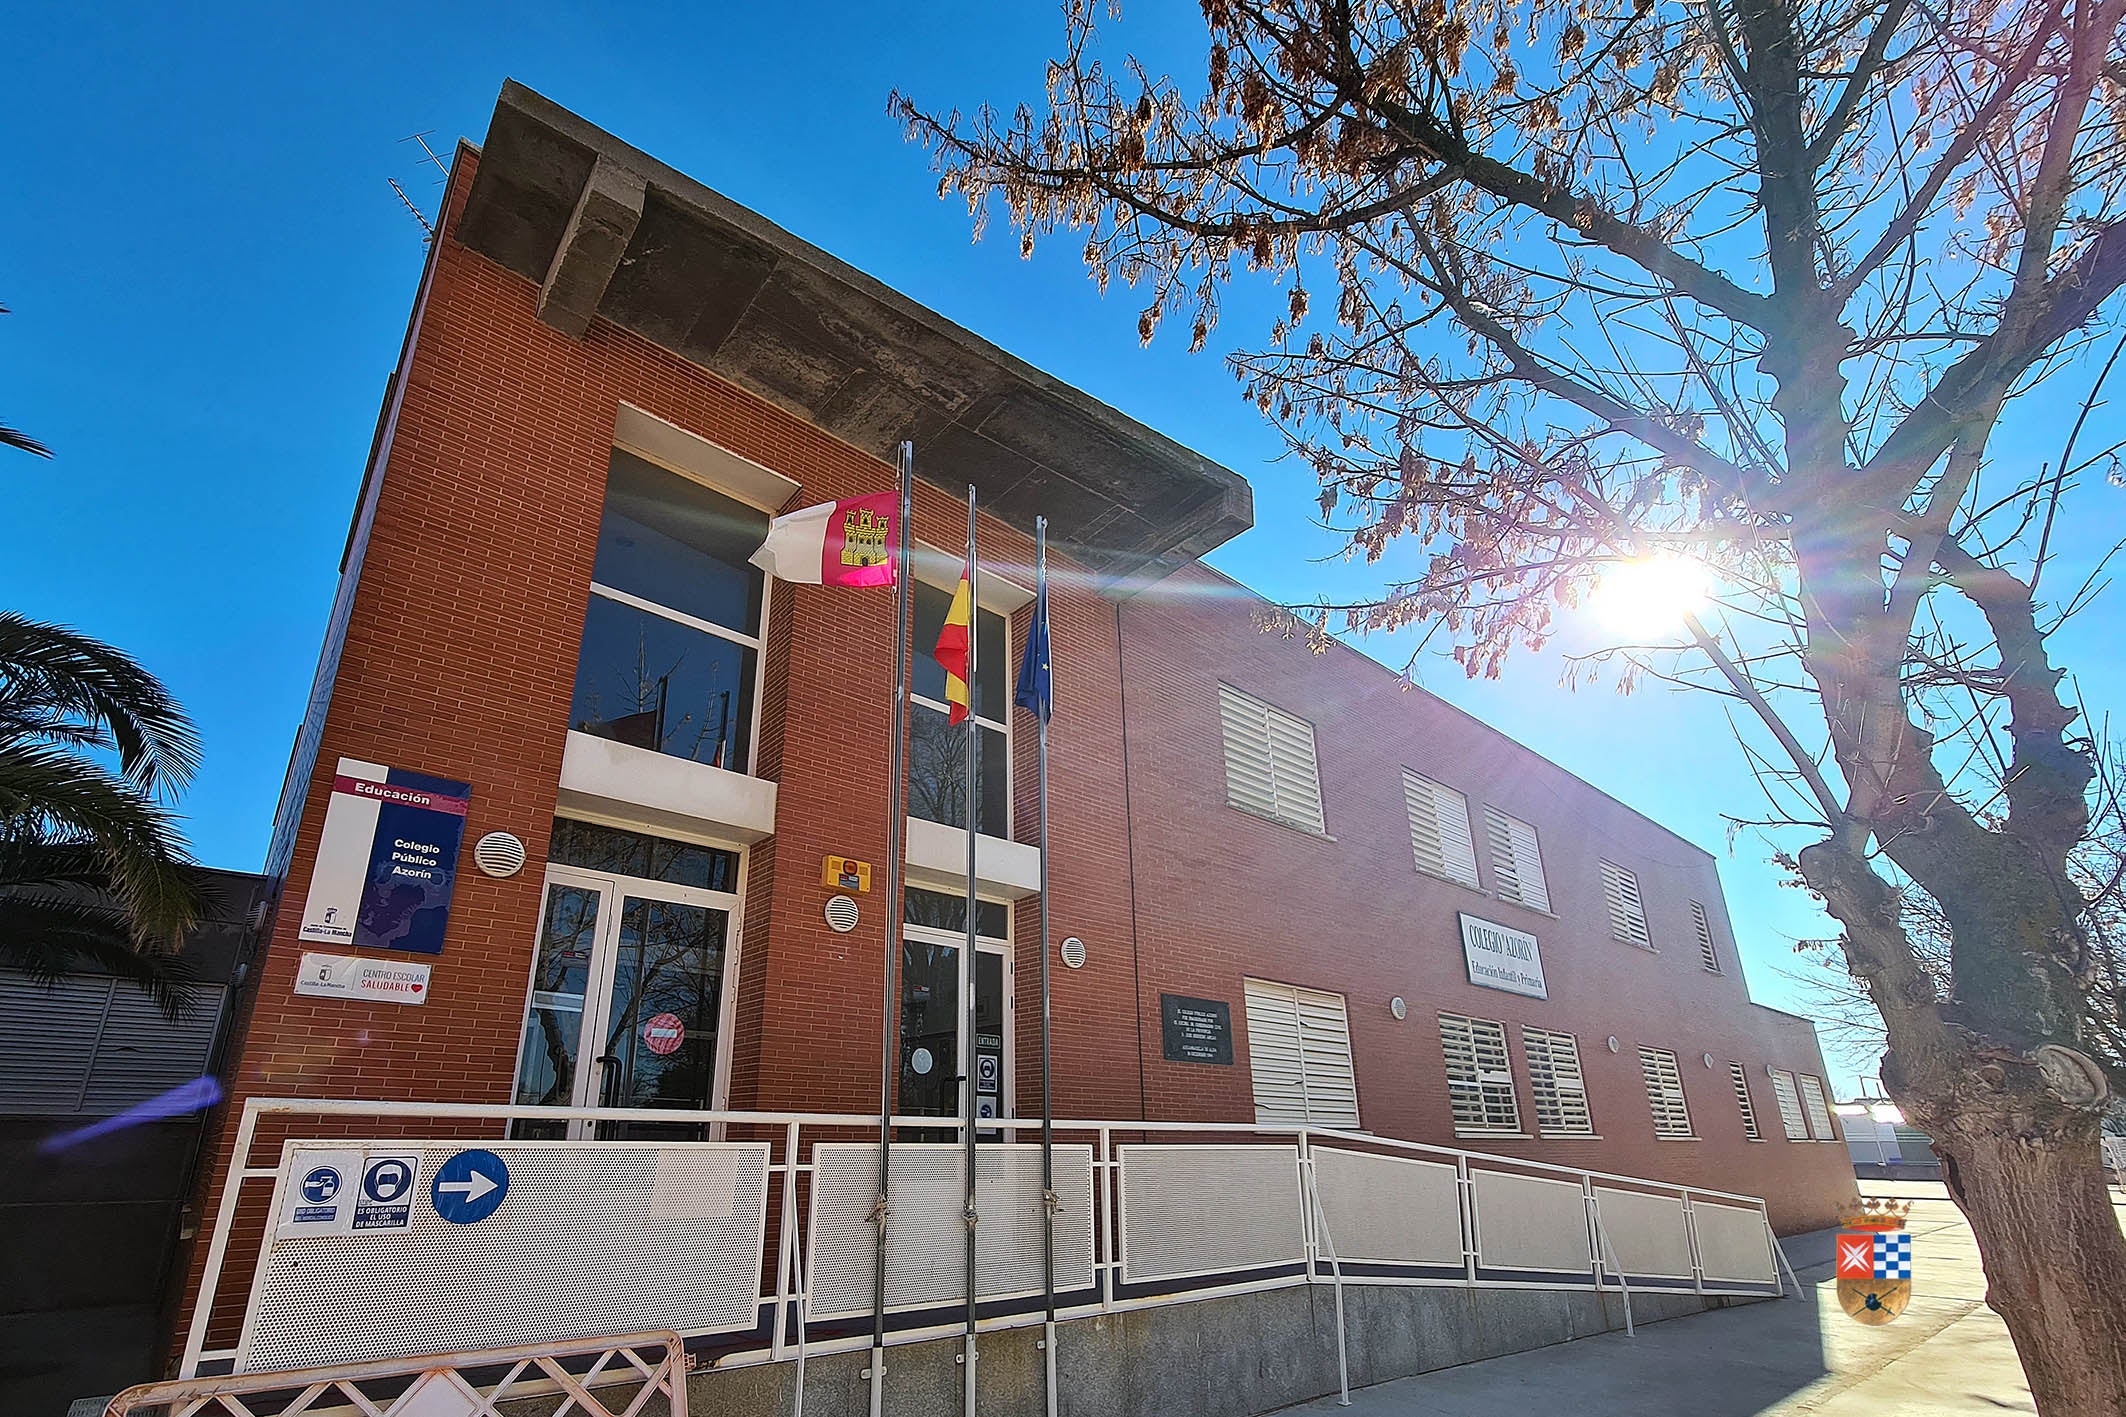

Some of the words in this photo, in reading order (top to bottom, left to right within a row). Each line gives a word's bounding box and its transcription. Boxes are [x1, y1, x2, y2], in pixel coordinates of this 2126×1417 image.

[355, 782, 431, 805] Educación
[394, 839, 440, 854] Colegio
[391, 852, 437, 867] Público
[391, 865, 432, 879] Azorín
[1469, 924, 1503, 954] COLEGIO
[363, 969, 391, 980] CENTRO
[392, 972, 425, 984] ESCOLAR
[1471, 960, 1498, 978] Educación
[1497, 966, 1518, 983] Infantil
[1520, 972, 1543, 989] Primaria
[360, 979, 409, 992] SALUDABLE
[978, 1036, 998, 1046] ENTRADA
[357, 1207, 365, 1215] ES
[365, 1206, 408, 1214] OBLIGATORIO
[364, 1219, 404, 1228] MASCARILLA
